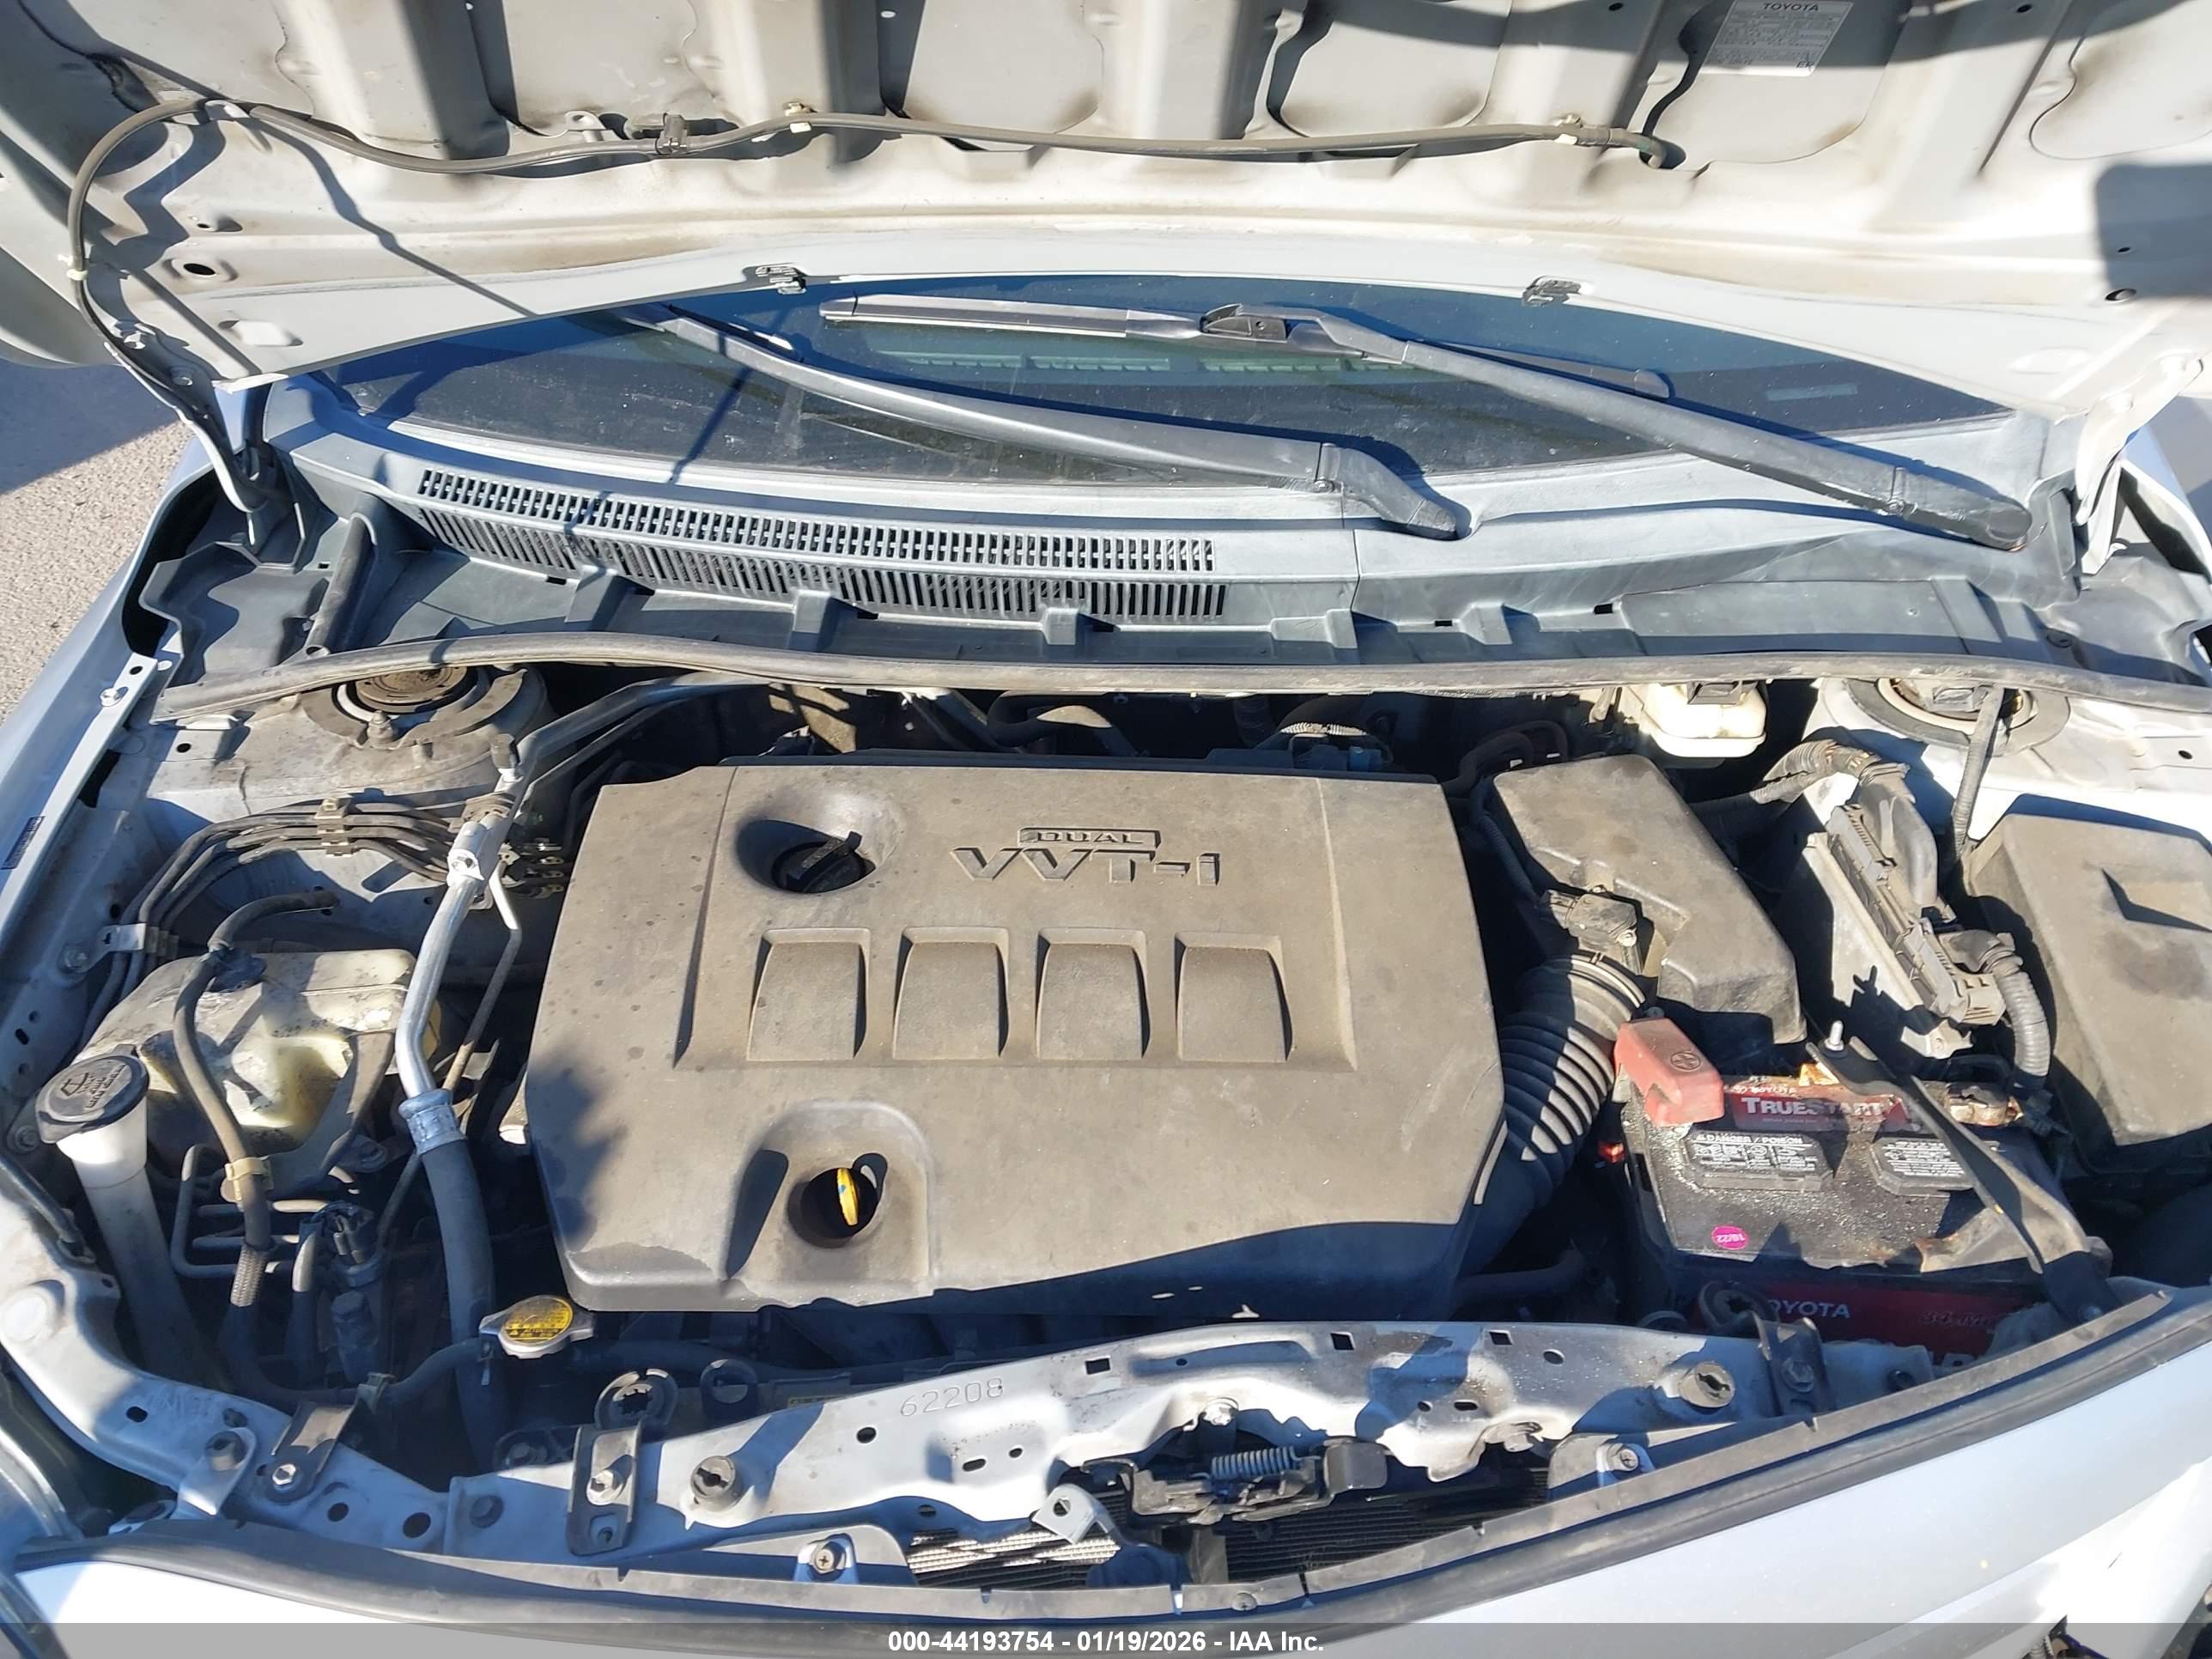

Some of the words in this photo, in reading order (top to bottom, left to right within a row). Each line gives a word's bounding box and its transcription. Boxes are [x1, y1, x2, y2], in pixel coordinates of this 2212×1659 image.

[1763, 3, 1819, 12] TOYOTA
[1036, 831, 1144, 844] DUAL
[950, 847, 1220, 886] VVT-i
[900, 1377, 1003, 1417] 62208
